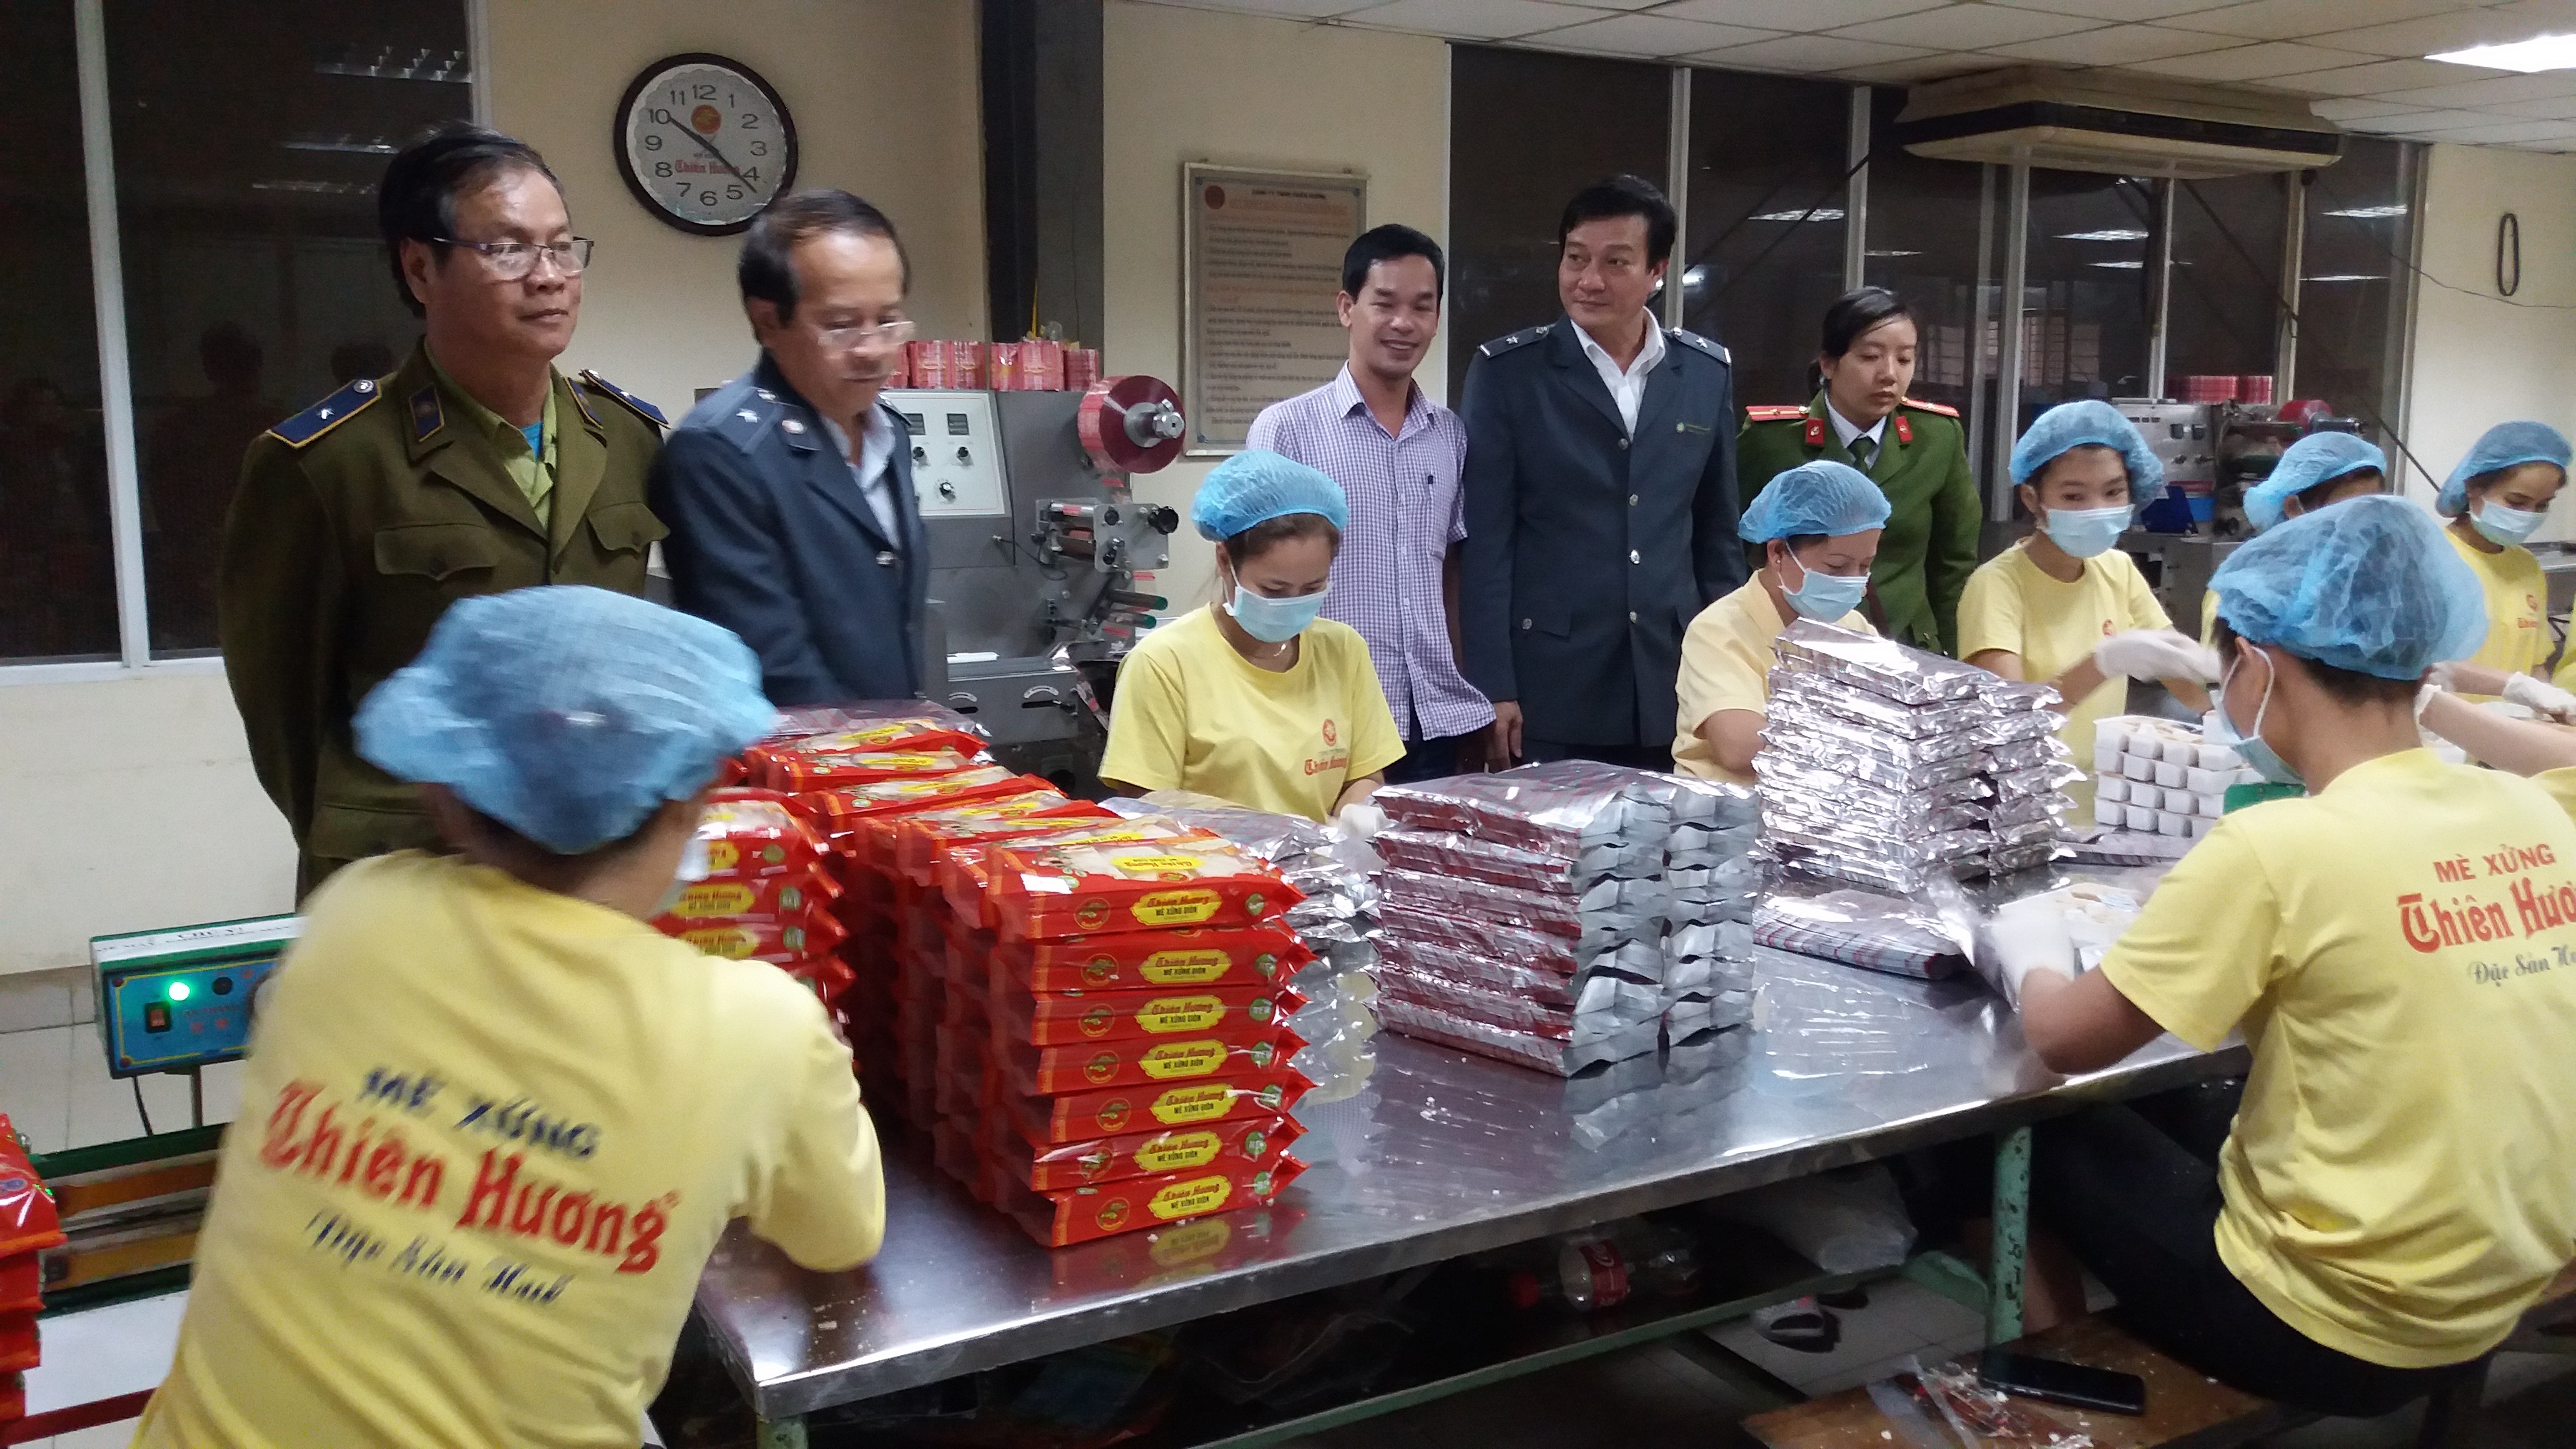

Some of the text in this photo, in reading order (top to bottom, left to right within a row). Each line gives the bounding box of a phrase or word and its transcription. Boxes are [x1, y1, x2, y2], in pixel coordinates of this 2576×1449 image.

[671, 90, 685, 105] 11
[693, 85, 716, 100] 12
[729, 94, 734, 108] 1
[649, 109, 671, 124] 10
[741, 114, 758, 129] 2
[645, 135, 662, 150] 9
[750, 141, 767, 156] 3
[655, 162, 673, 177] 8
[743, 167, 760, 181] 4
[676, 182, 691, 197] 7
[726, 185, 743, 200] 5
[700, 191, 718, 206] 6
[2433, 853, 2476, 882] MÈ
[2397, 877, 2576, 954] Thiên Hươ
[260, 1078, 446, 1209] Thiên
